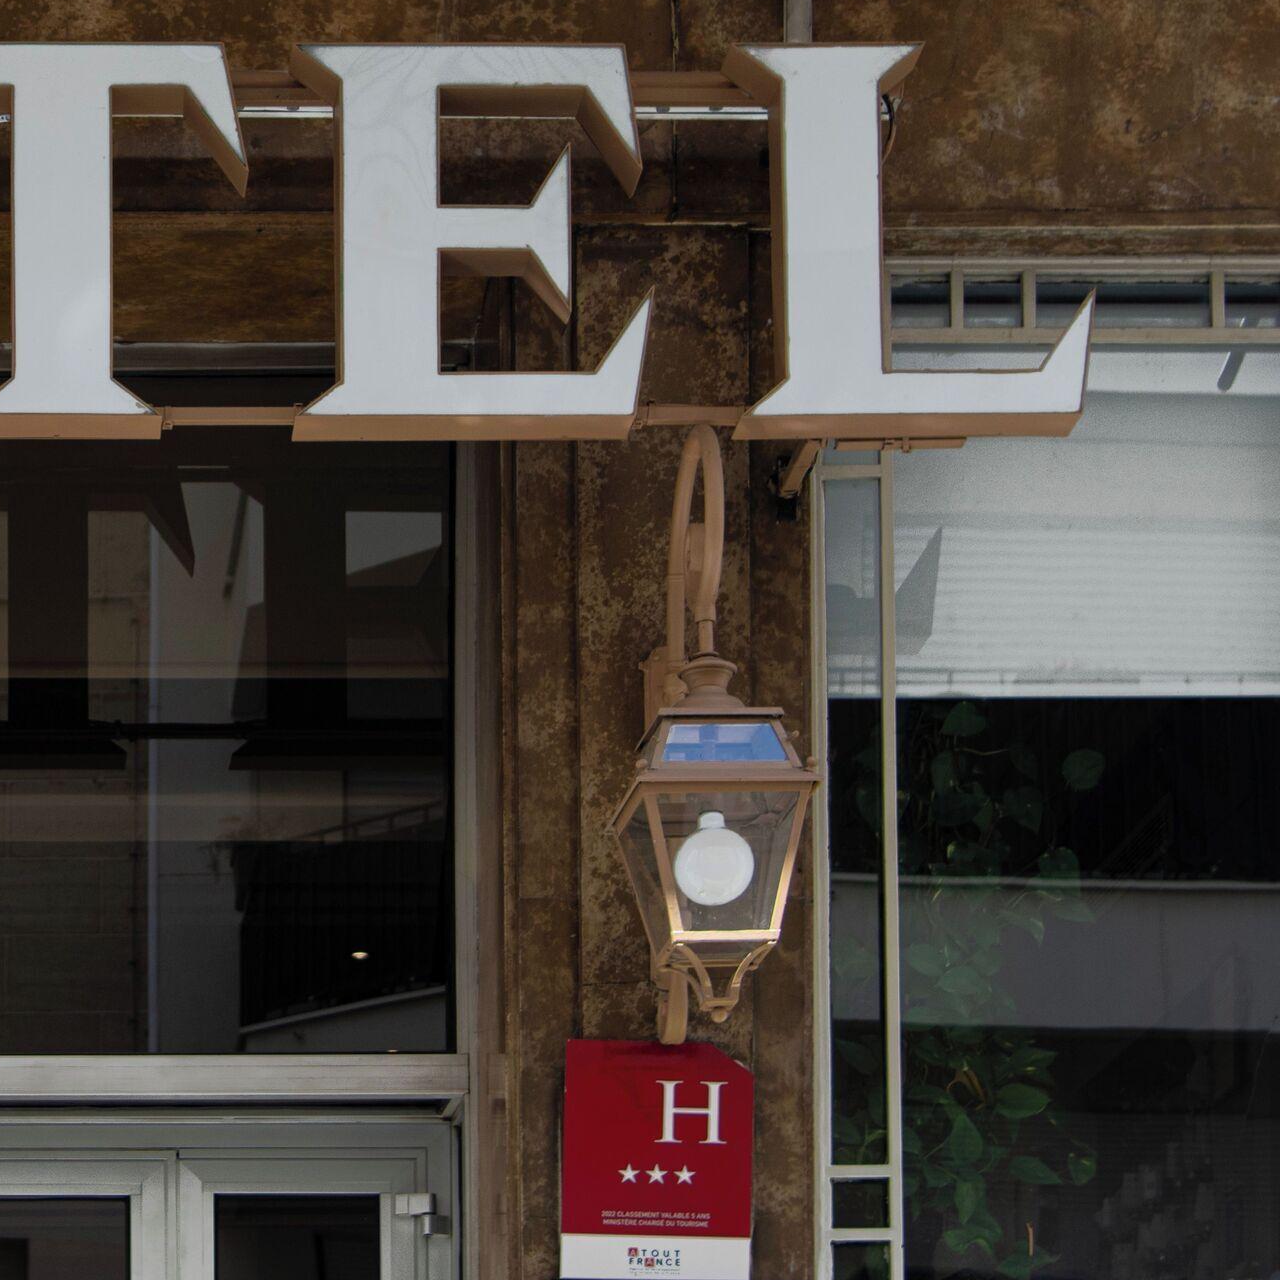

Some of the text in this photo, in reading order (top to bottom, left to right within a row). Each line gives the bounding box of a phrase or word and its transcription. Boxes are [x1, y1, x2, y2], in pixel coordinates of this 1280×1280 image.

[654, 1080, 728, 1144] H
[628, 1247, 680, 1257] ATOUT
[628, 1257, 681, 1267] FRANCE
